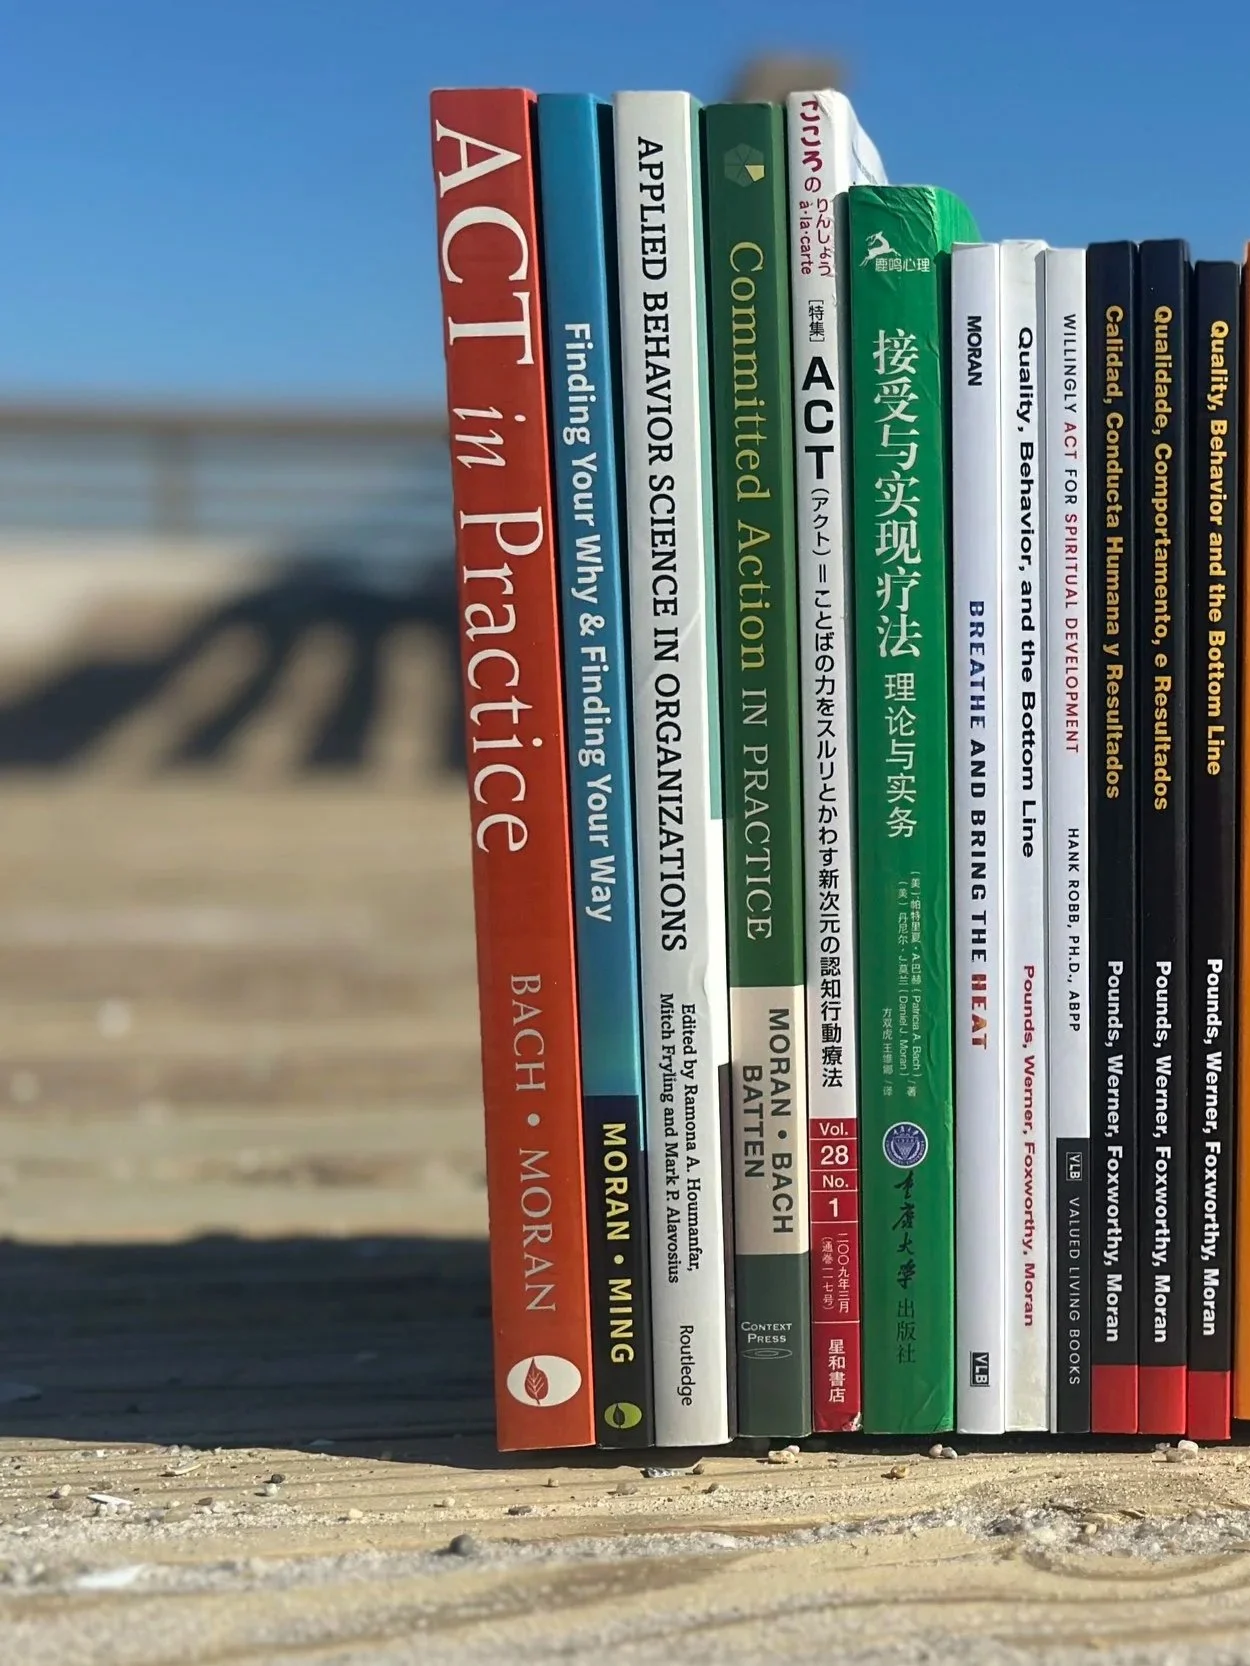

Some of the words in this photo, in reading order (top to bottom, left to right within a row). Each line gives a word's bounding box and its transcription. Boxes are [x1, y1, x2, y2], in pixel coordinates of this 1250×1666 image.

[800, 99, 823, 193] こころの
[436, 119, 534, 365] ACT
[637, 135, 667, 281] APPLIED
[815, 198, 833, 277] りんしょう
[875, 257, 931, 273] 鹿鸣心理
[563, 322, 596, 445] Finding
[642, 291, 674, 465] BEHAVIOR
[729, 241, 771, 502] Committed
[967, 315, 983, 387] MORAN
[1016, 326, 1034, 433] Quality,
[1063, 313, 1077, 414] WILLINGLY
[1103, 305, 1124, 405] Calidad,
[1152, 305, 1173, 436] Qualidade,
[1206, 320, 1229, 412] Quality,
[453, 405, 526, 469] in
[802, 356, 835, 480] ACT
[1063, 421, 1077, 460] ACT
[571, 452, 597, 527] Your
[873, 328, 923, 659] 接受与实现疗法
[1018, 442, 1035, 572] Behavior,
[1064, 468, 1078, 506] FOR
[1105, 412, 1124, 529] Conducta
[1209, 419, 1228, 526] Behavior
[571, 534, 604, 604] Why
[648, 474, 679, 617] SCIENCE
[1064, 513, 1079, 609] SPIRITUAL
[1151, 443, 1173, 645] Comportamento,
[1209, 532, 1228, 577] and
[579, 612, 605, 637] &
[736, 519, 771, 673] Action
[1019, 580, 1035, 632] and
[1105, 536, 1124, 635] Humana
[1208, 583, 1226, 623] the
[460, 506, 544, 853] Practice
[654, 627, 679, 663] IN
[968, 600, 986, 729] BREATHE
[1020, 640, 1036, 684] the
[1065, 617, 1079, 754] DEVELOPMENT
[1208, 630, 1226, 718] Bottom
[578, 646, 612, 768] Finding
[741, 686, 768, 727] IN
[1021, 691, 1036, 791] Bottom
[1105, 663, 1124, 799] Resultados
[1154, 675, 1172, 811] Resultados
[883, 671, 918, 839] 理论与实务
[970, 739, 986, 799] AND
[1206, 725, 1226, 777] Line
[586, 773, 612, 848] Your
[654, 673, 687, 952] ORGANIZATIONS
[743, 743, 773, 941] PRACTICE
[1021, 800, 1036, 859] Line
[1067, 828, 1080, 872] HANK
[585, 854, 616, 923] Way
[970, 809, 987, 901] BRING
[970, 910, 987, 963] THE
[1066, 879, 1080, 929] ROBB,
[1066, 935, 1080, 984] PH.D.,
[510, 973, 546, 1092] BACH
[659, 993, 676, 1041] Mitch
[681, 1003, 698, 1054] Edited
[971, 973, 987, 1050] HEAT
[1022, 965, 1035, 1049] Pounds,
[1068, 990, 1081, 1032] ABPP
[1104, 960, 1124, 1048] Pounds,
[658, 1044, 677, 1103] Fryling
[680, 1059, 698, 1080] by
[769, 1008, 792, 1117] MORAN
[1022, 1055, 1036, 1136] Werner,
[1104, 1054, 1124, 1138] Werner,
[663, 1106, 679, 1138] and
[684, 1084, 698, 1152] Ramona
[742, 1065, 765, 1178] BATTEN
[819, 1122, 849, 1136] Vol.
[820, 1145, 849, 1165] 28
[602, 1122, 630, 1241] MORAN
[664, 1142, 680, 1186] Mark
[771, 1152, 794, 1234] BACH
[822, 1175, 849, 1189] No.
[1021, 1141, 1036, 1256] Foxworthy,
[518, 1148, 556, 1312] MORAN
[666, 1206, 682, 1284] Alavosius
[686, 1177, 703, 1272] Houmanfar,
[828, 1203, 838, 1218] 1
[1068, 1197, 1081, 1260] VALUED
[1103, 1145, 1123, 1267] Foxworthy,
[608, 1278, 635, 1364] MING
[1023, 1262, 1036, 1328] Moran
[1069, 1267, 1081, 1322] LIVING
[1105, 1273, 1123, 1343] Moran
[676, 1324, 694, 1406] Routledge
[828, 1338, 846, 1403] 星和書店
[975, 1353, 989, 1384] VLB
[1069, 1329, 1081, 1385] BOOKS
